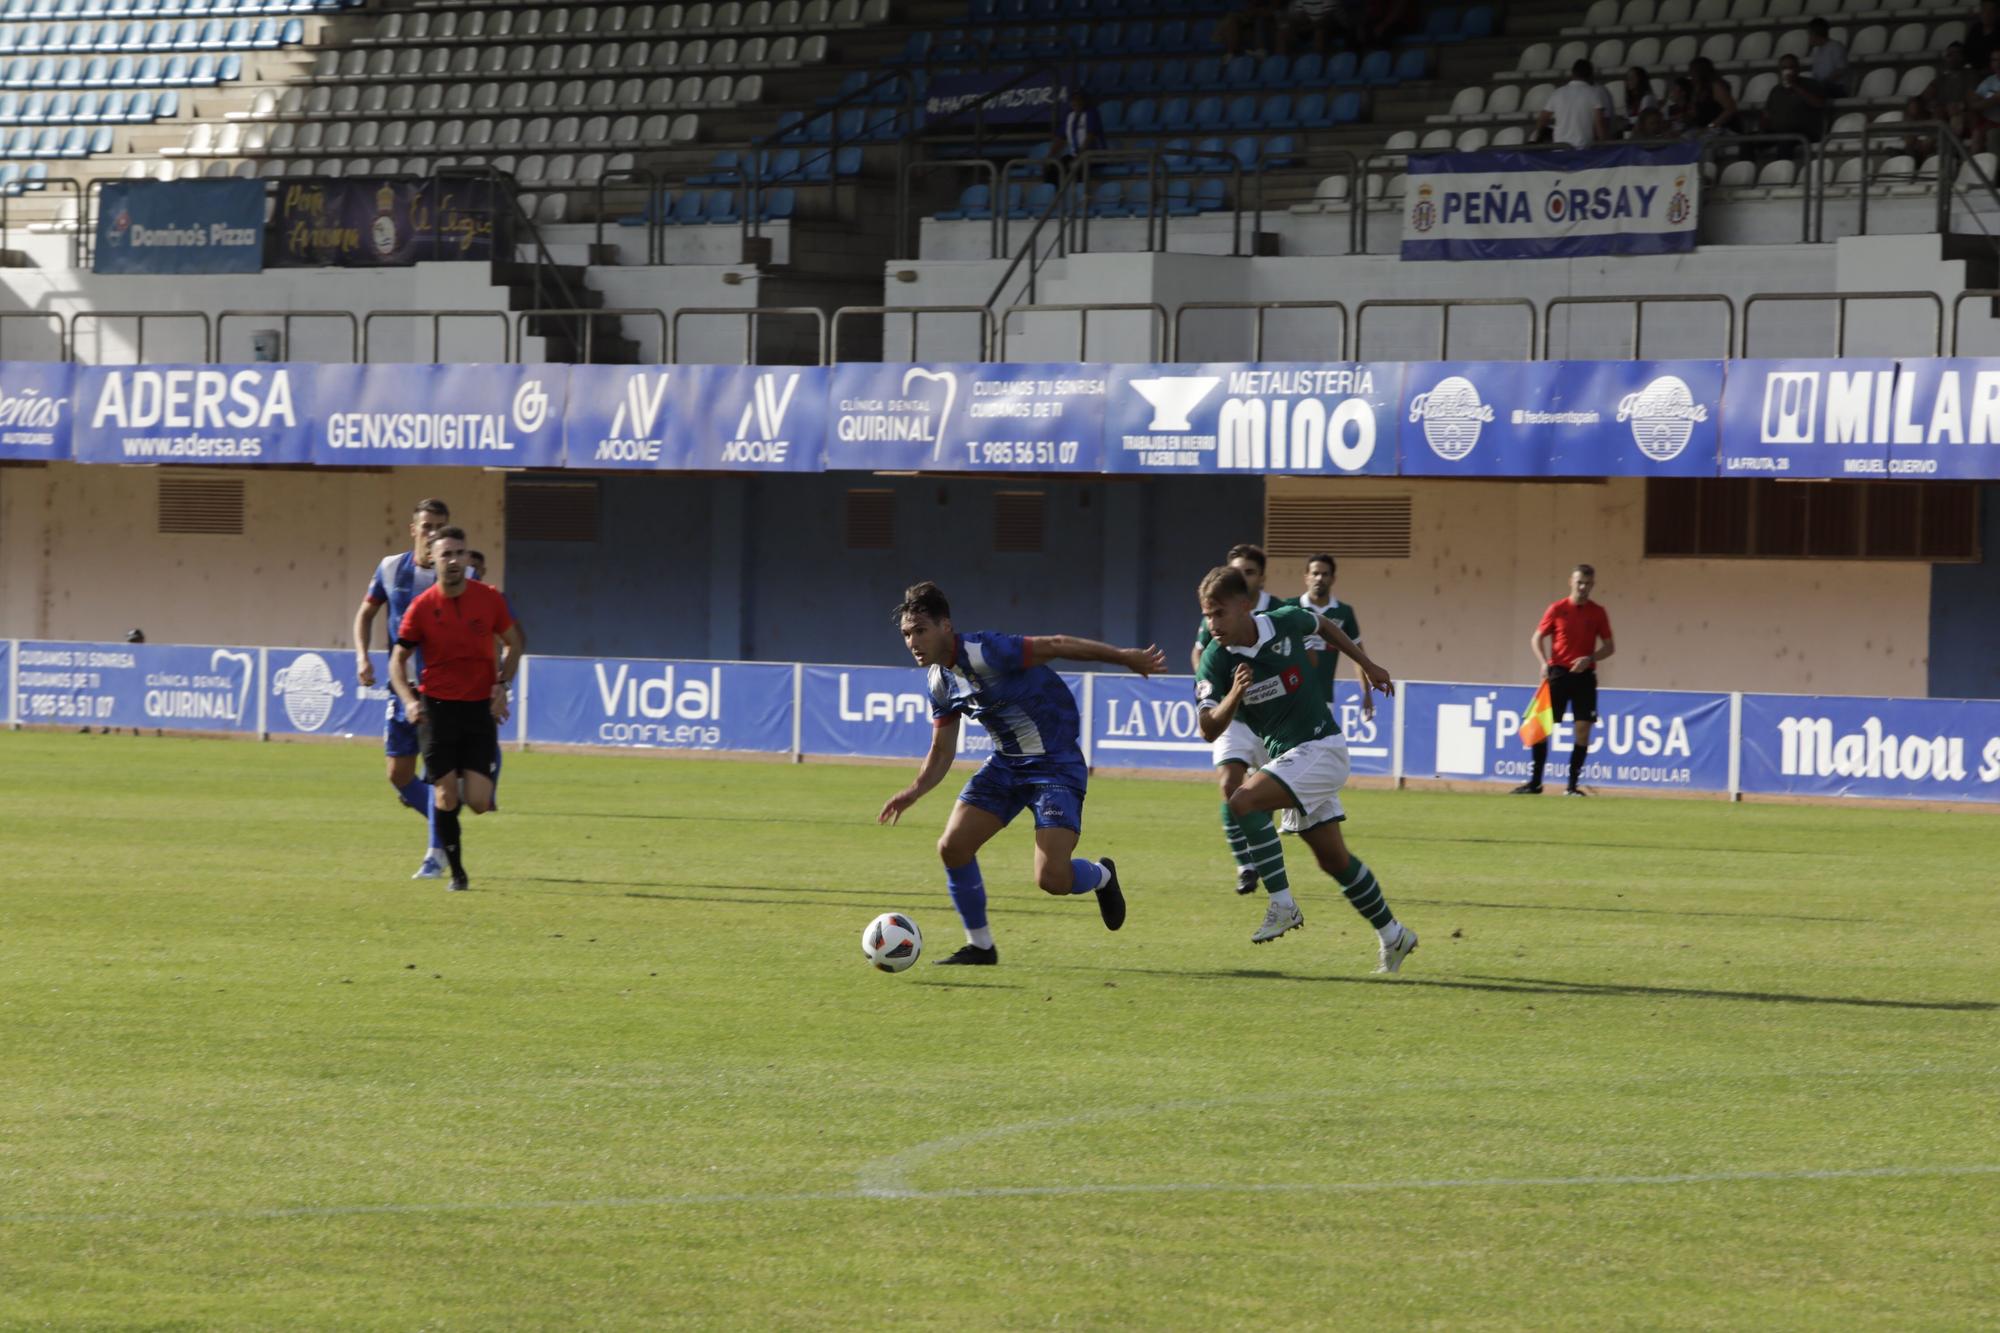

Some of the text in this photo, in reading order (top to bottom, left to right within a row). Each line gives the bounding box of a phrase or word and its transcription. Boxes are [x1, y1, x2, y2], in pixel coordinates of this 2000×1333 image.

[1442, 180, 1658, 224] PEÑA ÓRSAY
[130, 222, 256, 246] Domino's Pizza
[973, 380, 1105, 396] CUIDAMOS TU SONRISA
[1228, 365, 1374, 394] METALISTERÍA
[92, 369, 296, 428] ADERSA
[840, 398, 930, 412] CLÍNICA DENTAL
[1032, 402, 1049, 417] DE
[1051, 402, 1064, 416] TI
[1824, 371, 2000, 444] MILAR
[327, 412, 514, 450] GENXSDIGITAL
[838, 415, 935, 442] QUIRINAL
[122, 433, 262, 457] www.adersa.es
[966, 442, 1079, 465] T. 985 56 51 07
[1844, 459, 1938, 474] MIGUEL CUERVO
[146, 671, 233, 689] CLÍNICA DENTAL
[594, 663, 721, 720] Vidal
[144, 689, 238, 719] QUIRINAL
[1107, 700, 1146, 736] LA
[1149, 700, 1201, 738] VO
[1496, 710, 1691, 757] PECUSA
[1777, 716, 1967, 782] Mahou
[1495, 760, 1691, 784] CONSRUCCIÓN MODULAR
